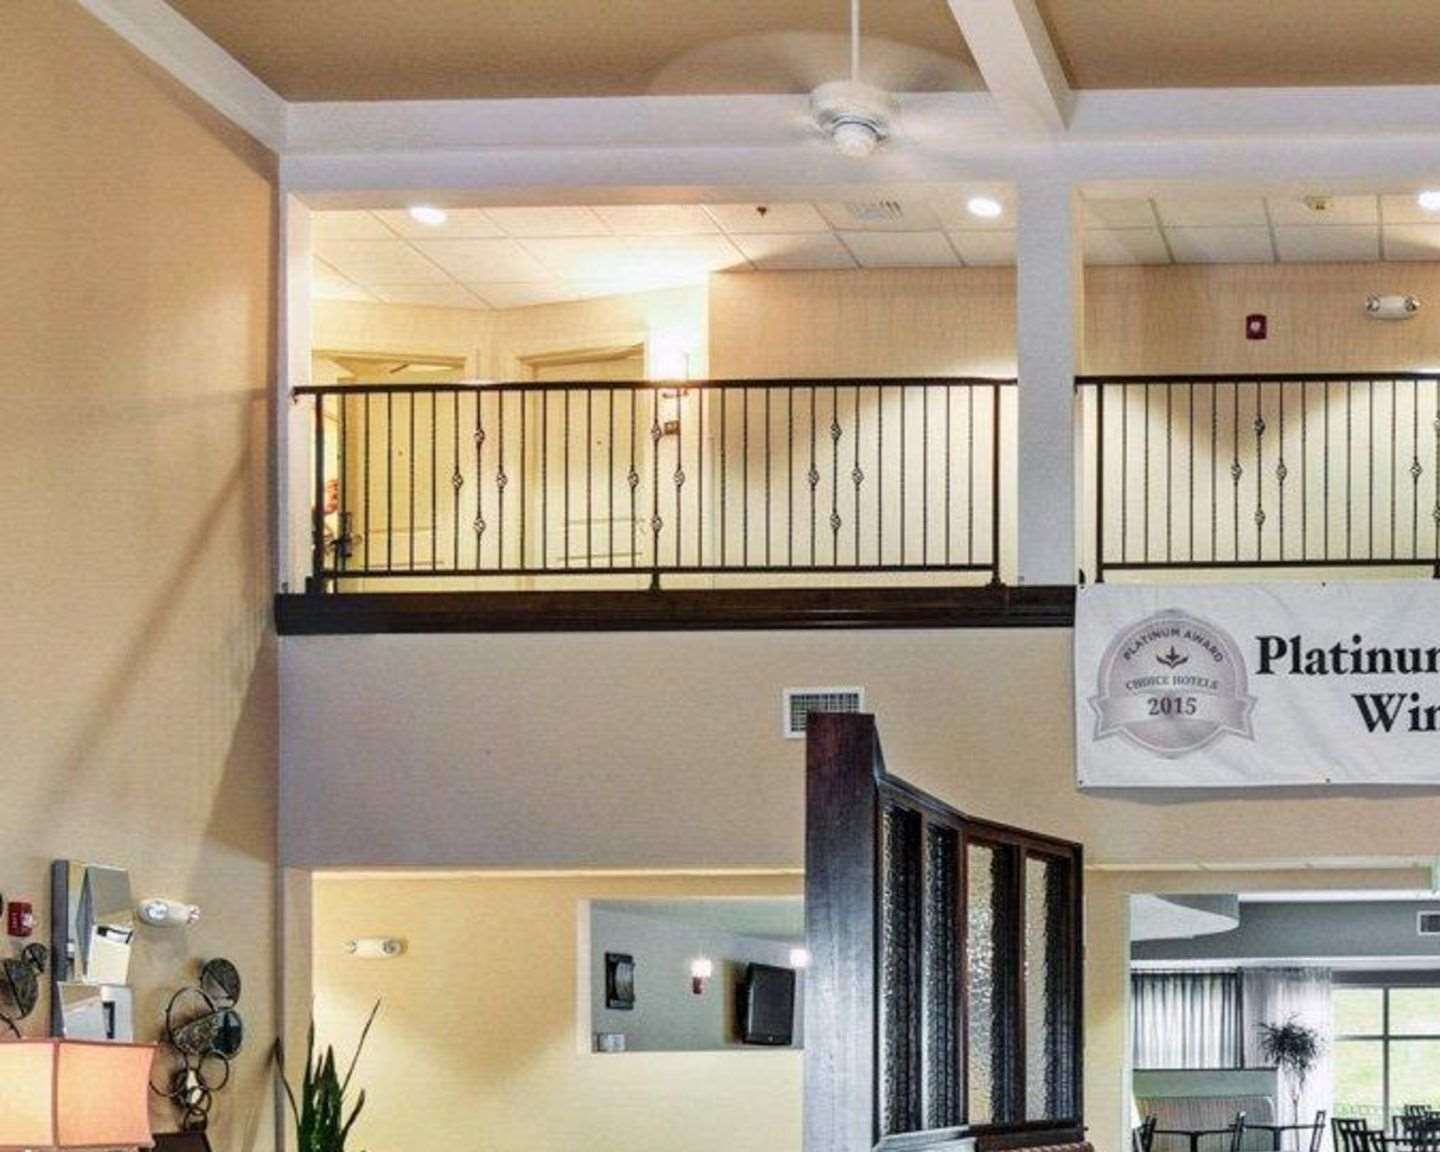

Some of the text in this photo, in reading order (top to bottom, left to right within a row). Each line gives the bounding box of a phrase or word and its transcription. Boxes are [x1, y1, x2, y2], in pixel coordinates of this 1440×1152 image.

[1123, 628, 1224, 663] PLATINUM AWARD
[1125, 675, 1219, 691] CHOICE HOTELS
[1147, 696, 1197, 716] 2015
